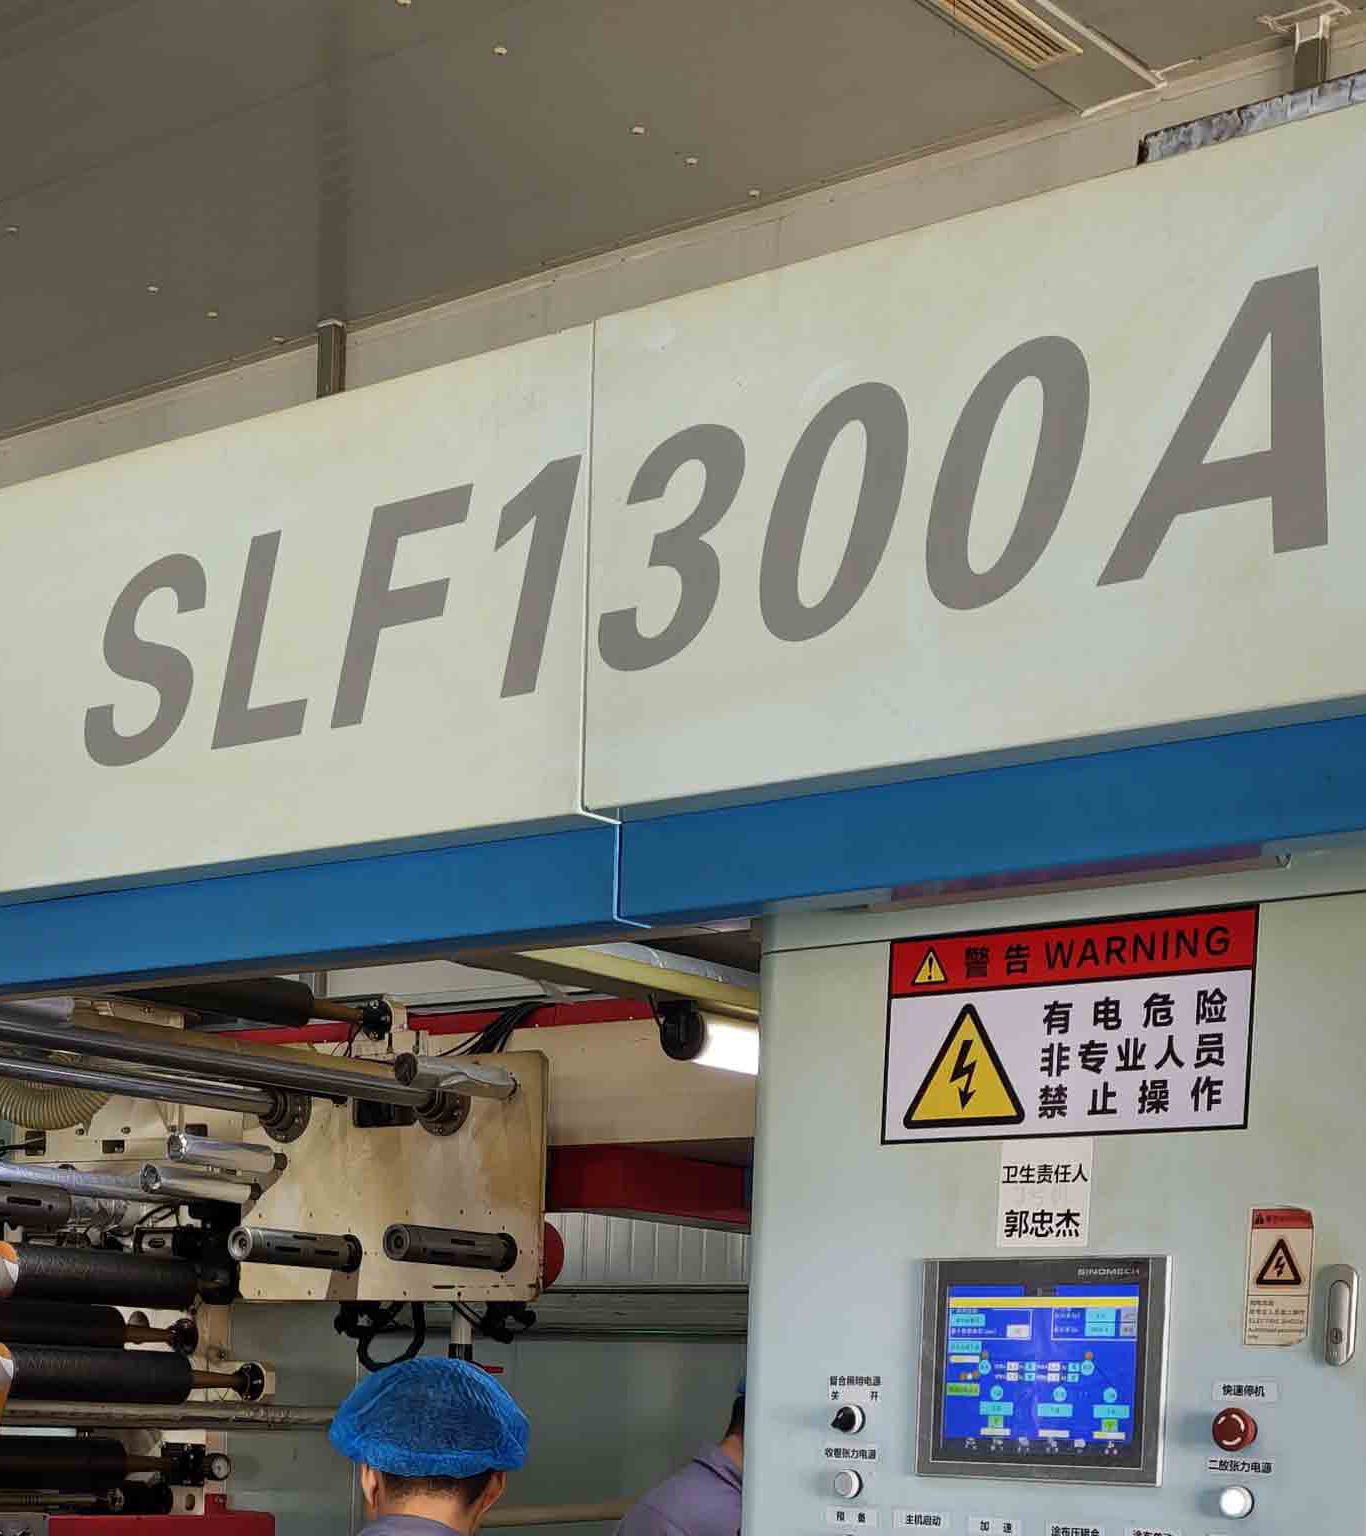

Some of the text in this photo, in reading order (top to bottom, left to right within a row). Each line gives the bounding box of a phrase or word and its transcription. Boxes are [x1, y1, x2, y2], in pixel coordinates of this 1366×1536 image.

[84, 267, 1327, 767] SLF1300A
[964, 924, 1231, 978] 警告 WARNING
[1042, 988, 1229, 1036] 有电危险
[1039, 1033, 1226, 1077] 非专业人员
[1037, 1076, 1224, 1120] 禁止操作
[1002, 1163, 1089, 1185] 卫生责任人
[1004, 1209, 1082, 1239] 郭忠杰
